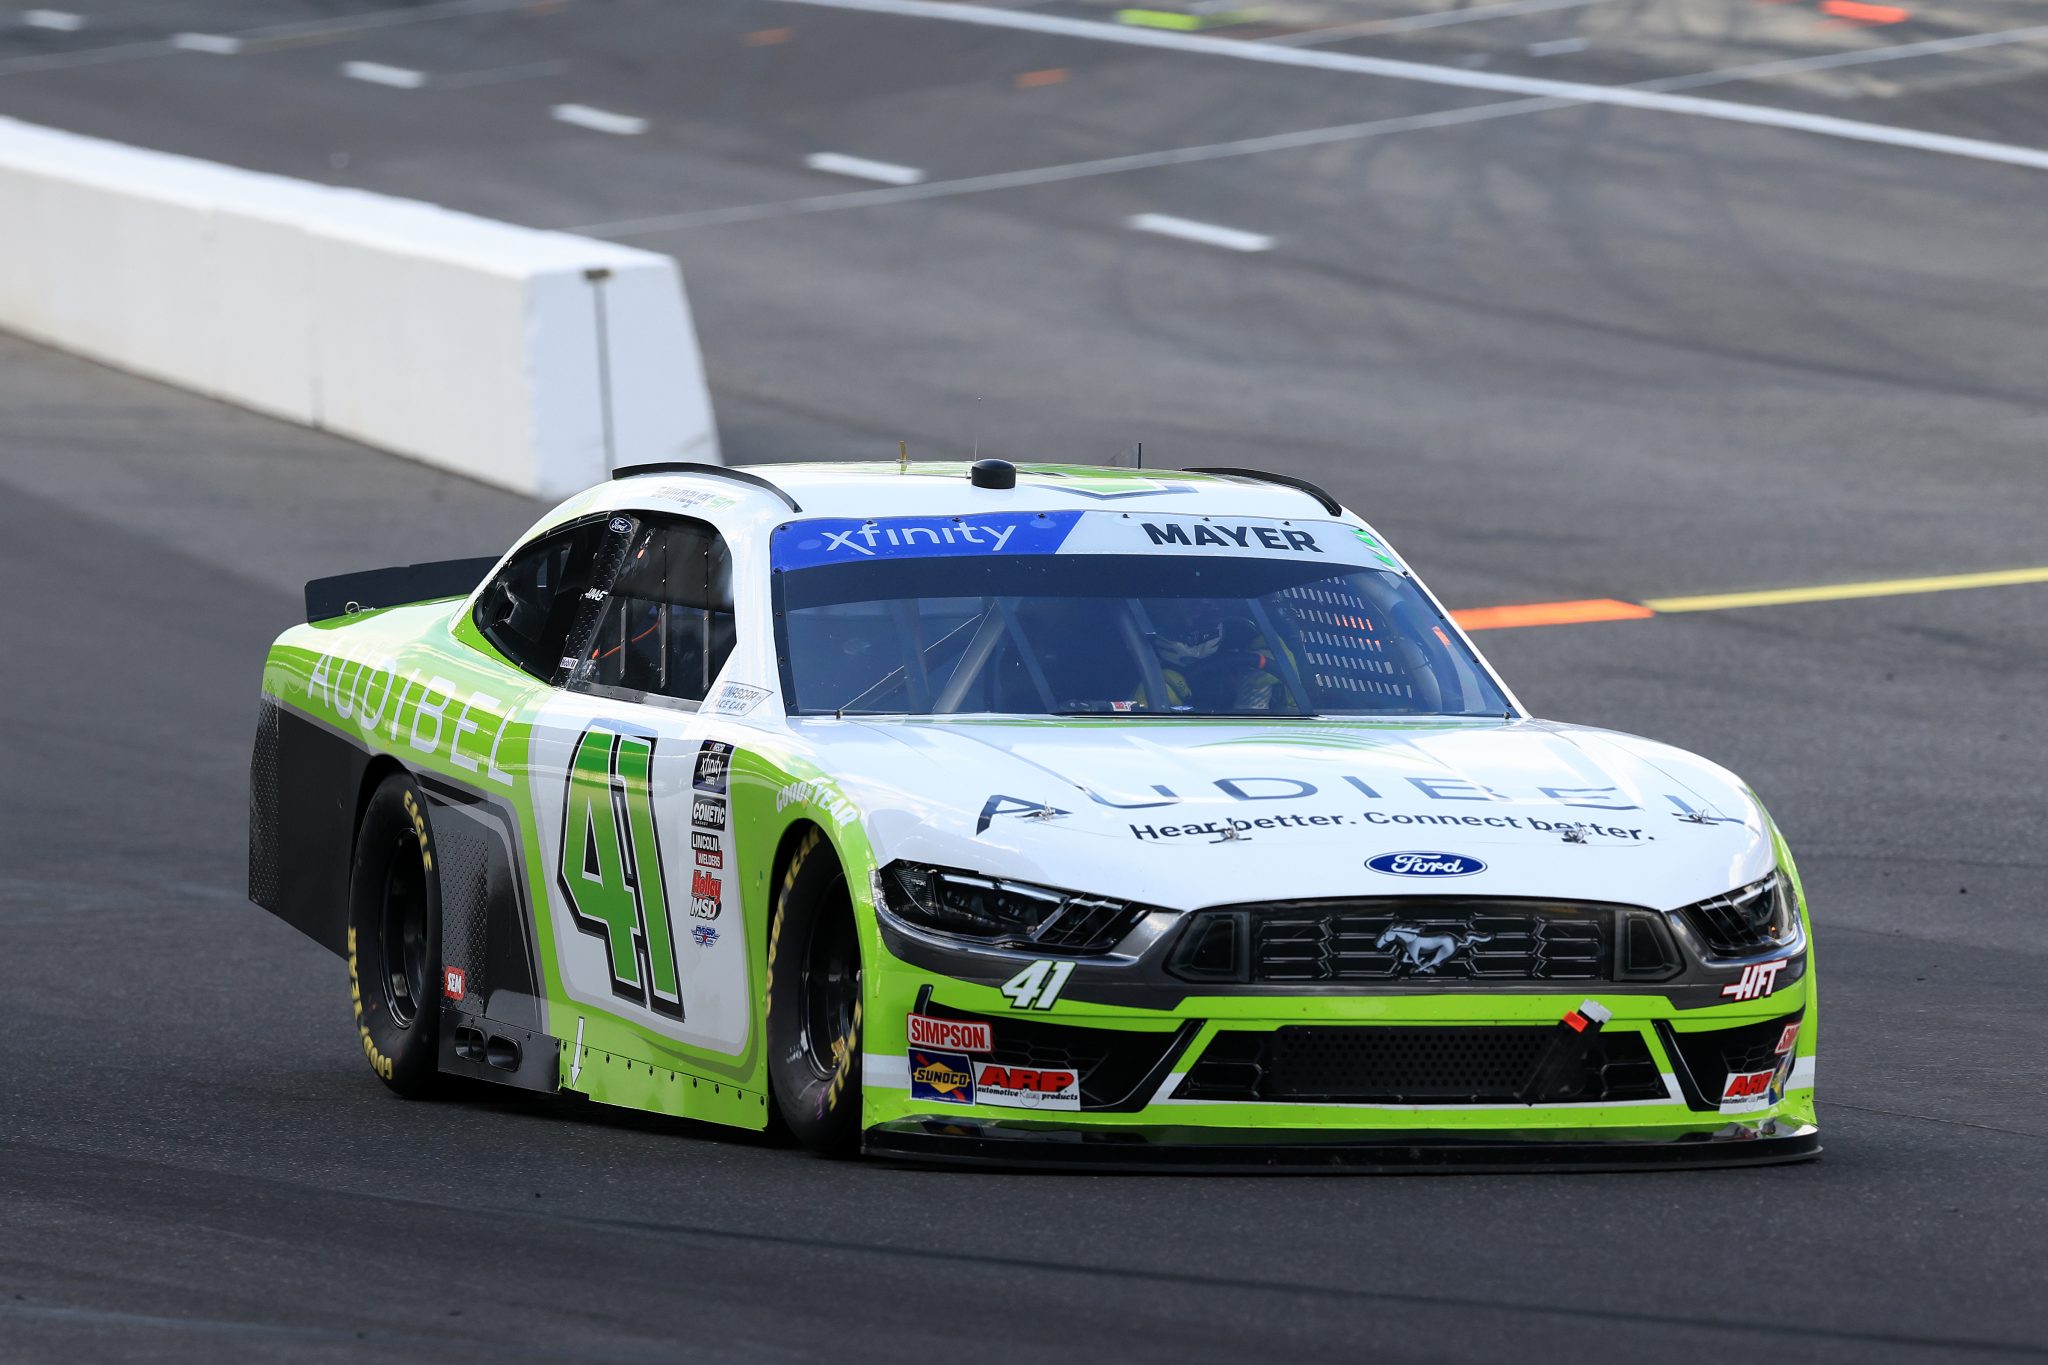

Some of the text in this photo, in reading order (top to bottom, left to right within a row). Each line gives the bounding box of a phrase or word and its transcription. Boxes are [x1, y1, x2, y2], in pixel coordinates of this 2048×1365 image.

[825, 516, 1017, 556] xfinity
[1140, 522, 1323, 553] MAYER
[307, 645, 514, 786] AUDIBEL
[693, 802, 725, 825] COMETIC
[1128, 820, 1218, 840] Hear
[1232, 812, 1357, 833] better.
[1364, 811, 1523, 830] Connect
[692, 833, 718, 852] LINCOLN
[557, 722, 684, 1022] 41
[698, 853, 721, 868] WELDERS
[1388, 853, 1465, 876] Ford
[692, 869, 721, 905] Holley
[690, 897, 718, 920] MSD
[1001, 960, 1077, 1010] 41
[911, 1018, 986, 1049] SIMPSON
[915, 1067, 970, 1088] SUNOCO
[978, 1065, 1075, 1092] ARP
[977, 1086, 1019, 1097] automotive
[1041, 1093, 1079, 1101] products
